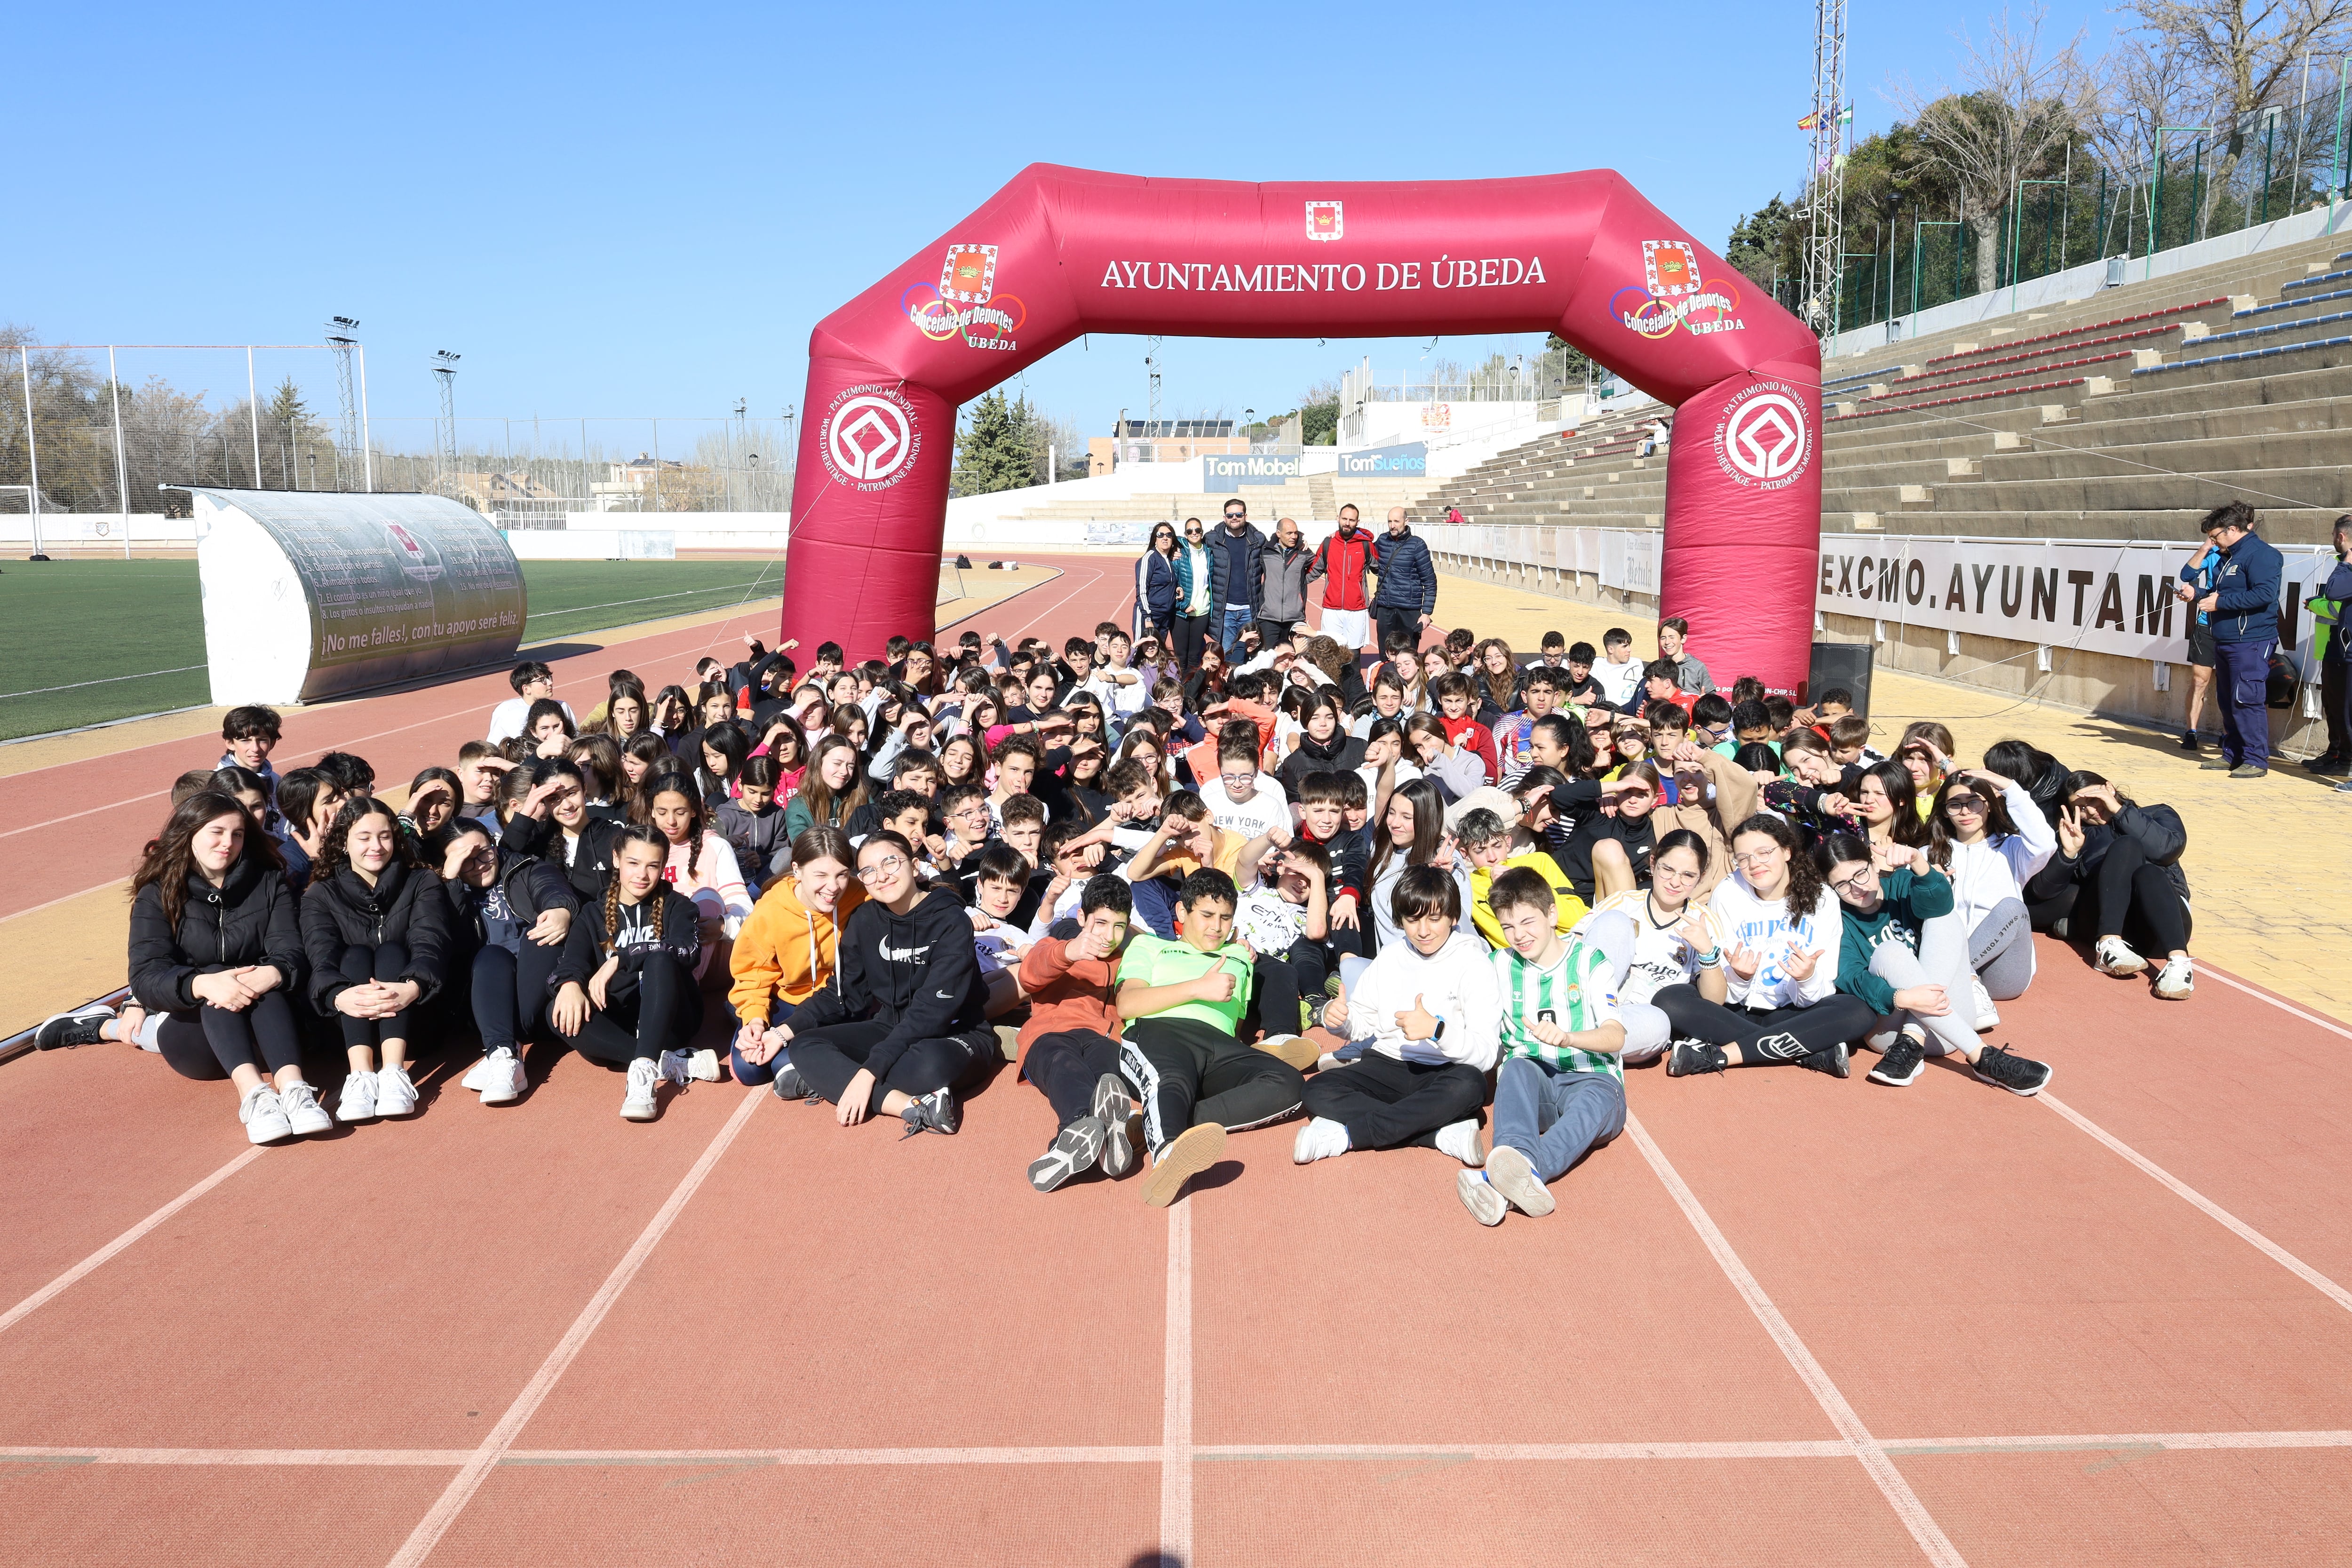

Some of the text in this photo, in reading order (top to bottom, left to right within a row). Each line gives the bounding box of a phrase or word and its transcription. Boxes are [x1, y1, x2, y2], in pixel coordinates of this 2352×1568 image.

[1101, 254, 1546, 292] AYUNTAMIENTO DE ÚBEDA
[910, 304, 1013, 333] Concejalía de Deportes
[1624, 292, 1732, 333] Concejalía de Deportes
[1690, 319, 1745, 335] ÚBEDA
[968, 333, 1017, 350] ÚBEDA
[829, 384, 918, 424] PATRIMONIO MUNDIAL
[1723, 382, 1810, 420] PATRIMONIO MUNDIAL
[820, 418, 848, 486] WORLD HERITAGE
[857, 431, 922, 492] PATRIMOINE MONDIAL
[1714, 423, 1750, 486] WORLD HERITAGE
[1760, 427, 1812, 490] PATRIMOINE MONDIAL
[1206, 458, 1299, 476] Tom Mobel
[309, 535, 337, 544] encanta!
[298, 549, 306, 558] 4.
[306, 549, 319, 559] Soy
[450, 557, 459, 565] 13.
[459, 556, 473, 565] Dejad
[307, 560, 385, 573] 5. Disfrutad con el partido.
[1627, 556, 1652, 589] Betula
[314, 579, 321, 588] 6.
[322, 577, 356, 587] Animadnos
[361, 575, 380, 585] todos.
[318, 594, 326, 604] 7.
[326, 593, 333, 603] El
[333, 591, 361, 603] contrario
[368, 590, 377, 599] un
[377, 588, 389, 598] niño
[390, 587, 403, 599] igual
[404, 589, 415, 598] que
[414, 588, 423, 597] yo.
[323, 611, 328, 620] 8.
[330, 609, 340, 619] Los
[341, 607, 358, 620] gritos
[364, 604, 385, 616] insultos
[395, 603, 413, 614] ayudan
[321, 611, 518, 655] ¡No me falles!, con tu apoyo seré feliz.
[1213, 816, 1265, 829] NEW YORK
[1998, 915, 2018, 937] SMILE
[1979, 938, 1999, 958] TODAY
